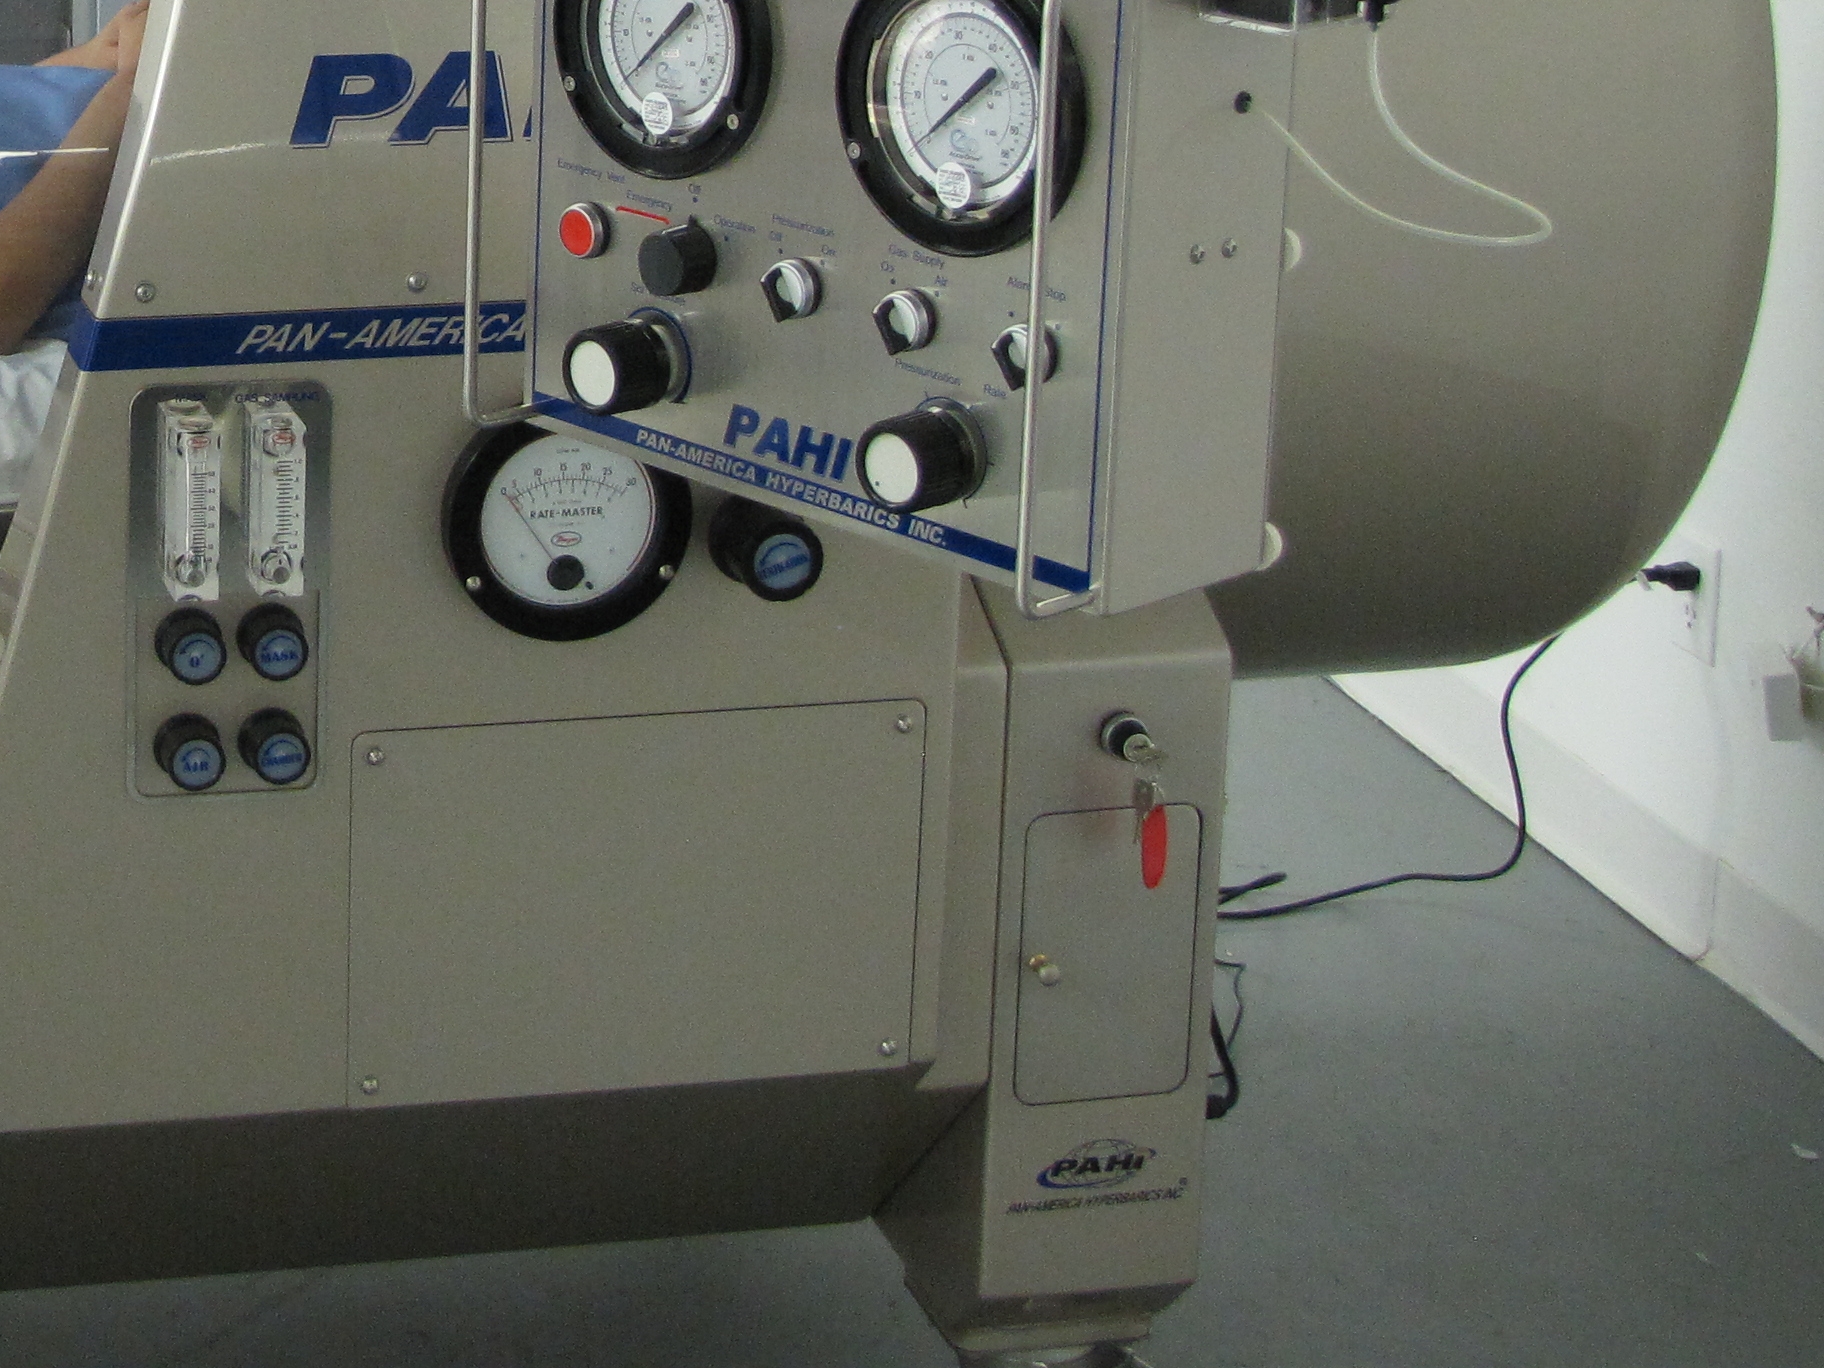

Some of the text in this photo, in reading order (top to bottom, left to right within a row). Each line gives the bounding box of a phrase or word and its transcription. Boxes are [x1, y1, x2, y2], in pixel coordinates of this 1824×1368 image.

[289, 50, 532, 149] PA
[557, 158, 603, 181] Emergency
[626, 189, 674, 213] Emergency
[713, 213, 757, 233] Operation
[888, 243, 945, 270] Gas Supply
[935, 275, 948, 287] Air
[894, 358, 962, 386] Pressurization
[983, 383, 1007, 399] Rate
[722, 403, 854, 482] PAHI
[534, 468, 542, 477] 10
[560, 462, 567, 471] 15
[581, 462, 591, 471] 20
[603, 467, 613, 476] 25
[626, 477, 636, 487] 30
[635, 429, 947, 547] PAN-AMERICA HYPERBARICS INC.
[500, 486, 507, 495] 0
[529, 506, 604, 519] RATE-MASTER
[183, 761, 209, 773] AIR
